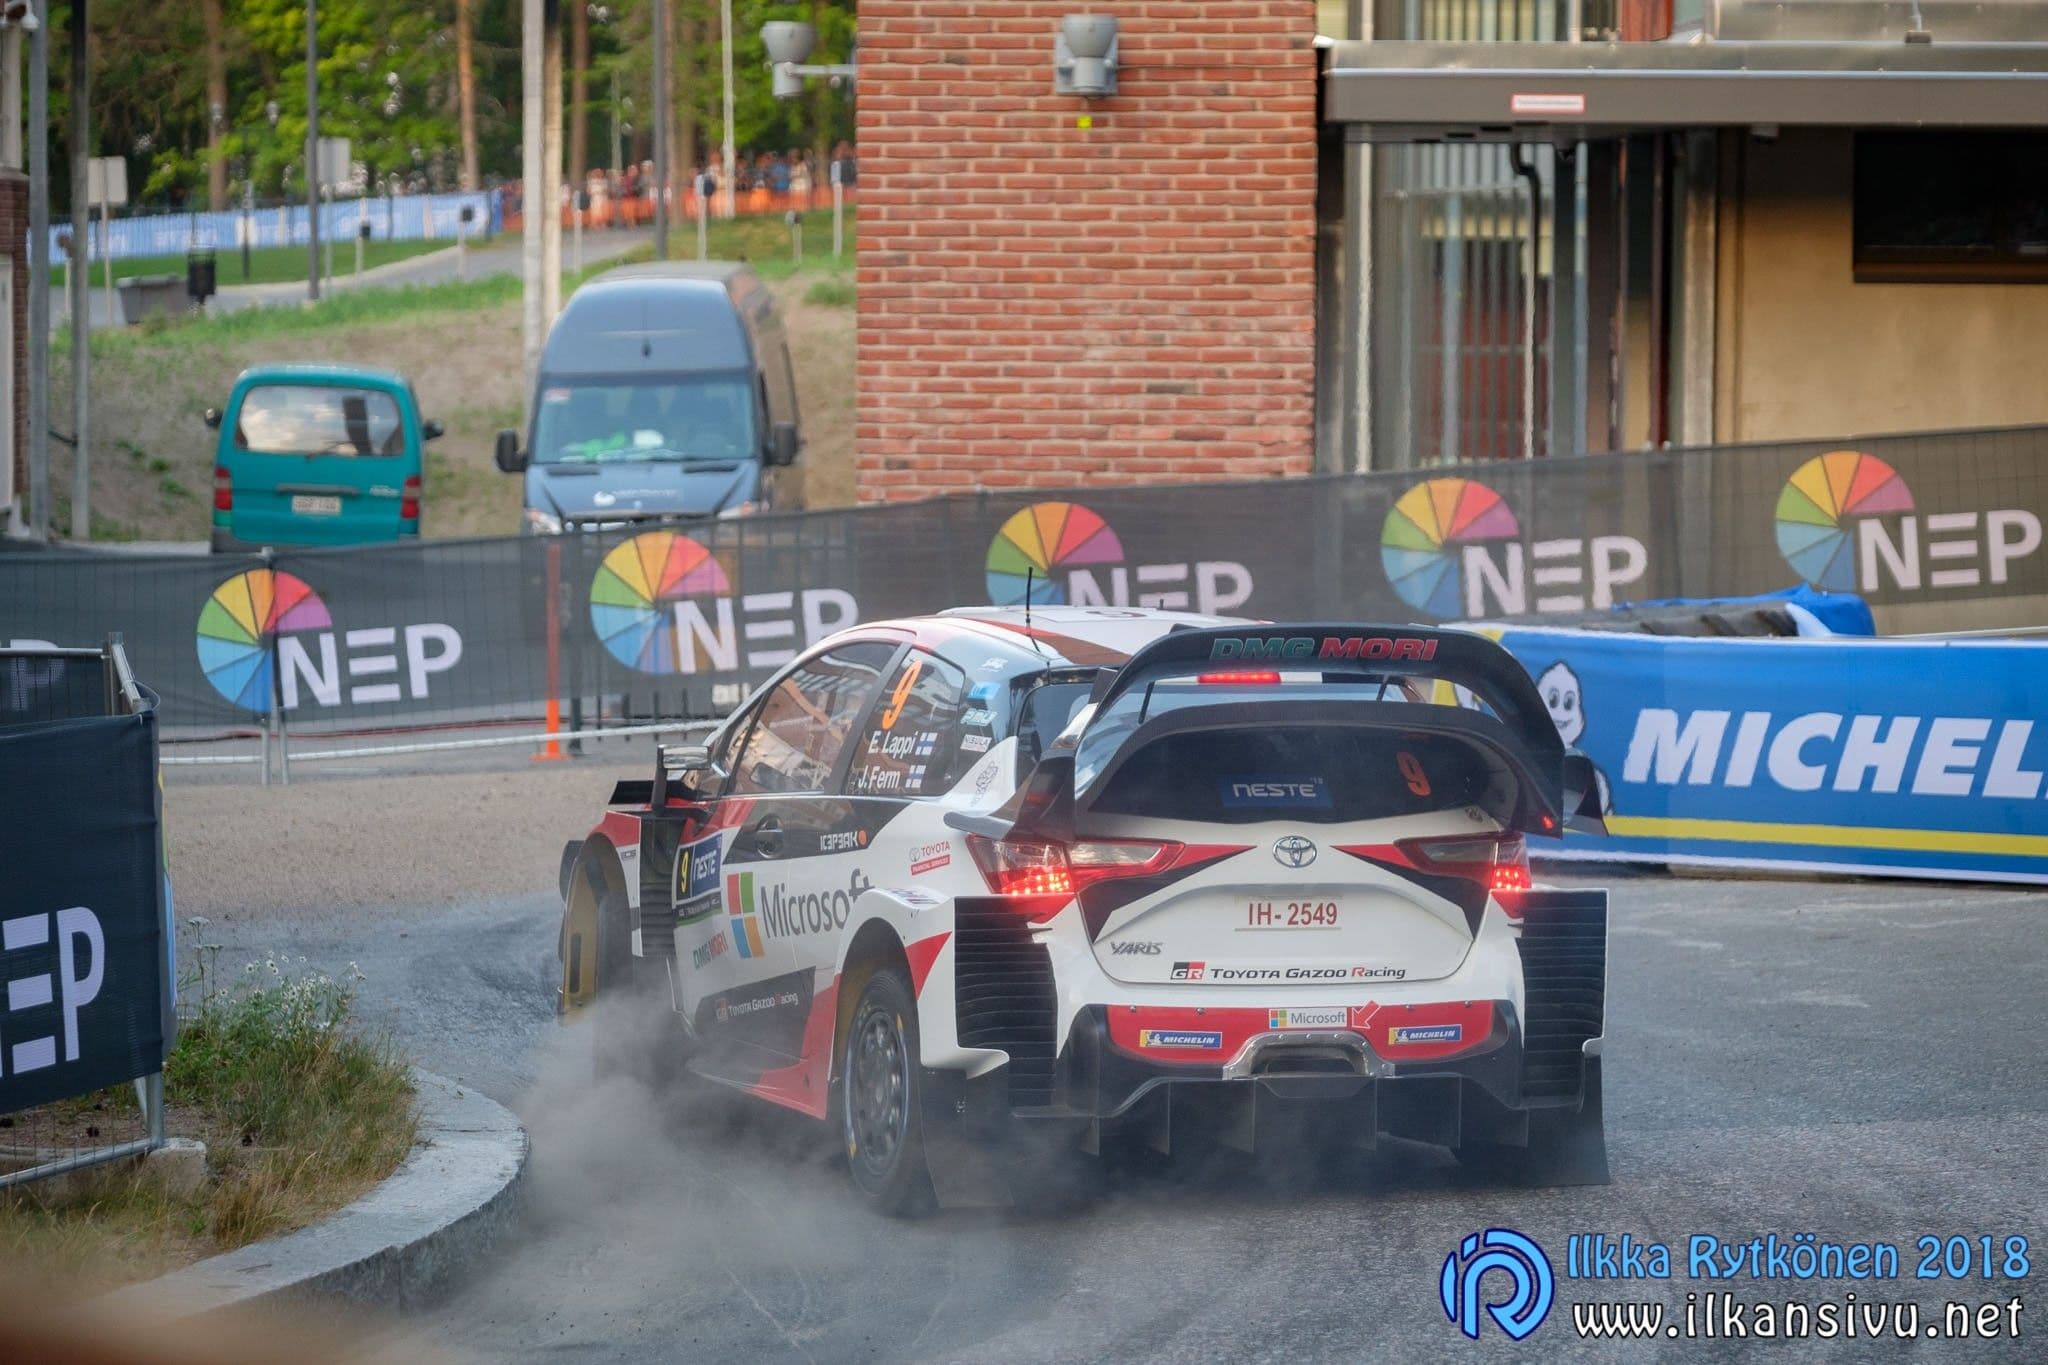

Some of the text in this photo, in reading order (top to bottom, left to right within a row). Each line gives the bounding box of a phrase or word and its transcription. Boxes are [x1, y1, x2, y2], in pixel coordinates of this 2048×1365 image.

[1858, 509, 2042, 593] NEP
[1068, 561, 1253, 617] NEP
[1463, 535, 1648, 616] NEP
[673, 588, 859, 673] NEP
[1209, 637, 1439, 661] DMG MORI
[278, 623, 463, 711] NEP
[881, 659, 922, 730] 9
[868, 730, 919, 759] E. Lappi
[1622, 708, 2048, 799] MICHEL
[857, 765, 901, 789] J. Ferm
[1396, 751, 1432, 797] 9
[1232, 783, 1317, 798] NESTE
[921, 840, 950, 857] TOYOTA
[681, 850, 689, 893] 9
[1110, 941, 1163, 956] YARIS
[1210, 967, 1281, 980] TOYOTA
[1285, 967, 1347, 979] GAZOO
[1351, 966, 1406, 980] Racing
[0, 906, 105, 1080] EP
[752, 996, 775, 1011] GAZOO
[1290, 1011, 1346, 1025] Microsoft
[1163, 1034, 1216, 1045] MICHELIN
[1409, 1029, 1456, 1040] MICHELIN
